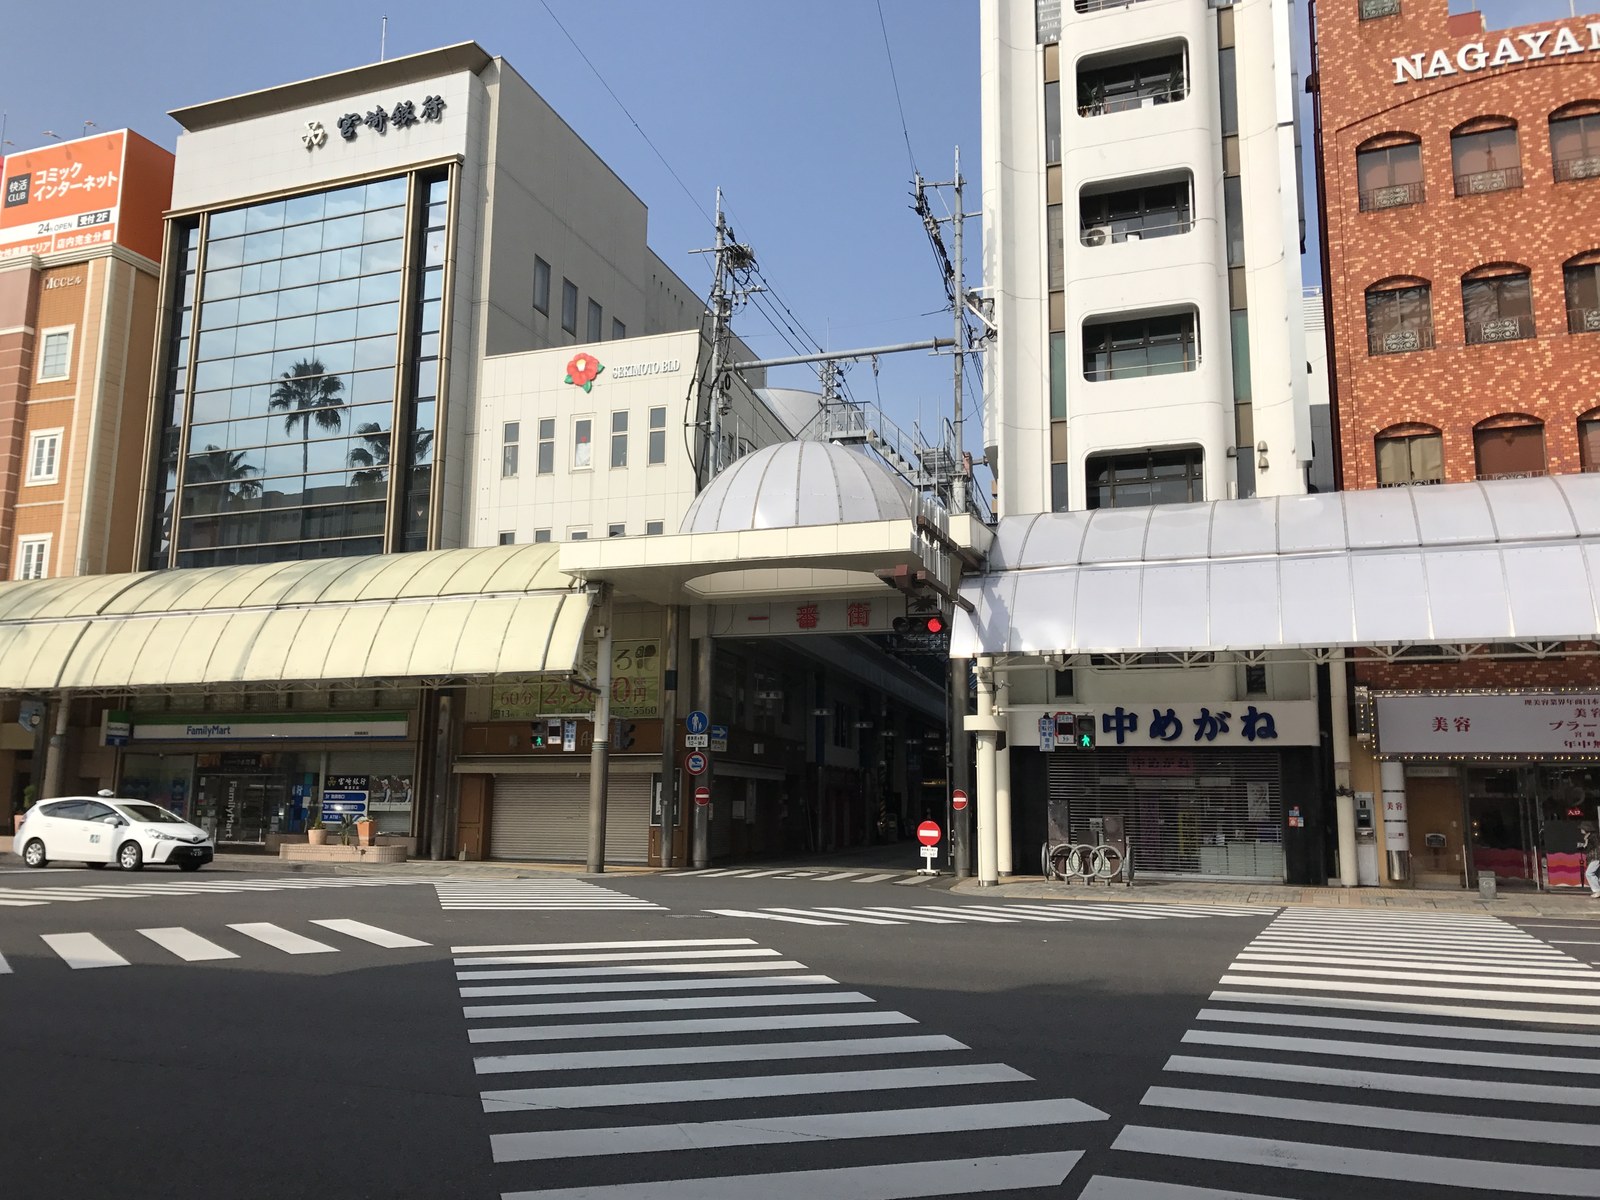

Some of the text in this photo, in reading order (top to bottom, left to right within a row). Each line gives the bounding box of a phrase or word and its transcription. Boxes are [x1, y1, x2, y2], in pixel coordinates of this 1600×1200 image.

[337, 95, 446, 139] 宮崎銀行
[35, 162, 83, 185] コミック
[9, 179, 28, 193] 快活
[33, 171, 118, 201] インターネット
[8, 191, 26, 203] CLUB
[54, 221, 73, 232] OPEN
[612, 362, 660, 379] SEKIMOTO
[747, 602, 872, 629] 一番街
[186, 725, 231, 737] FamilyMart
[1103, 706, 1278, 744] 中めがね
[1432, 716, 1471, 733] 美容
[225, 780, 238, 839] FamilyMart
[1387, 802, 1403, 811] 美容
